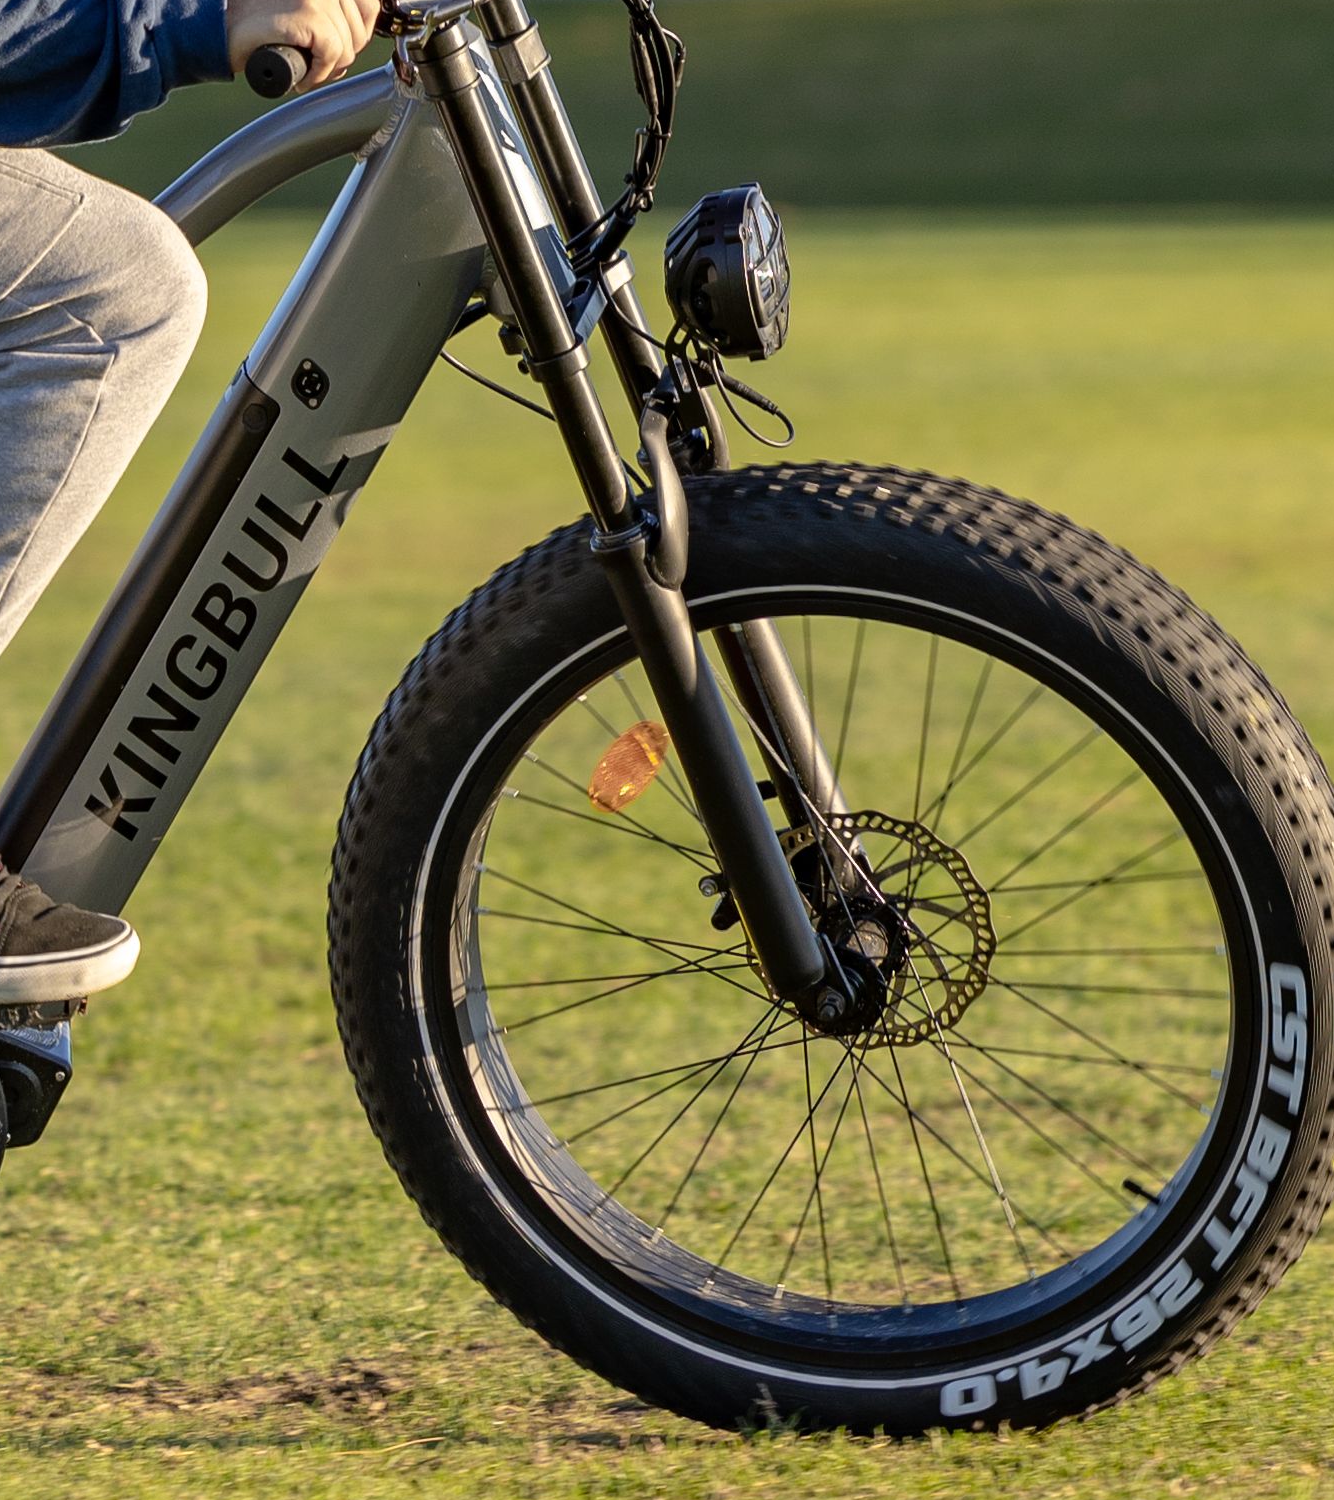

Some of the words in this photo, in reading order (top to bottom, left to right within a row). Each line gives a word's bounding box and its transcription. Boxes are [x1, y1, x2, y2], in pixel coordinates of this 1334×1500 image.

[84, 446, 349, 842] KINGBULL
[1268, 962, 1307, 1116] CST
[1203, 1114, 1291, 1271] BFT
[940, 1257, 1203, 1416] 26x4.0
